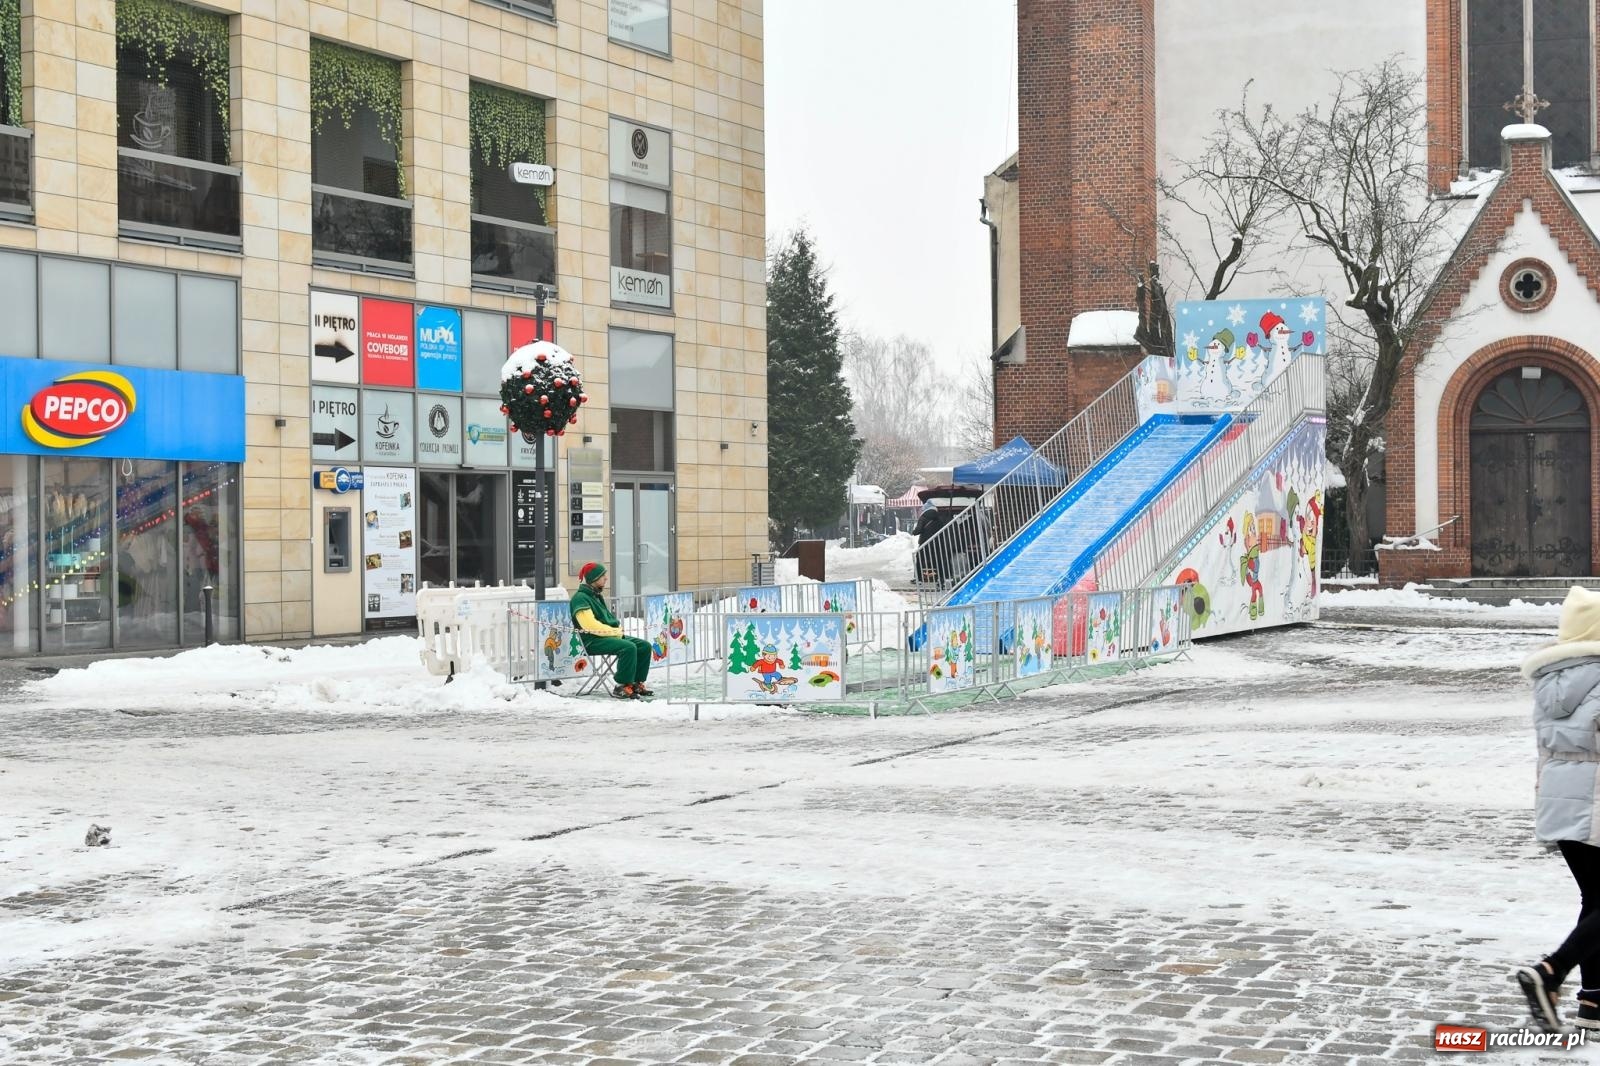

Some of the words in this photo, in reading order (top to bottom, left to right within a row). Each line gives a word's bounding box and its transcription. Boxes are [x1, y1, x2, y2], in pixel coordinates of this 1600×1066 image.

[517, 165, 551, 181] kemøn
[618, 271, 663, 297] kemøn
[314, 314, 320, 327] II
[323, 315, 355, 332] PIĘTRO
[367, 341, 401, 355] COVEBO
[44, 395, 120, 423] PEPCO
[319, 401, 356, 418] PIĘTRO
